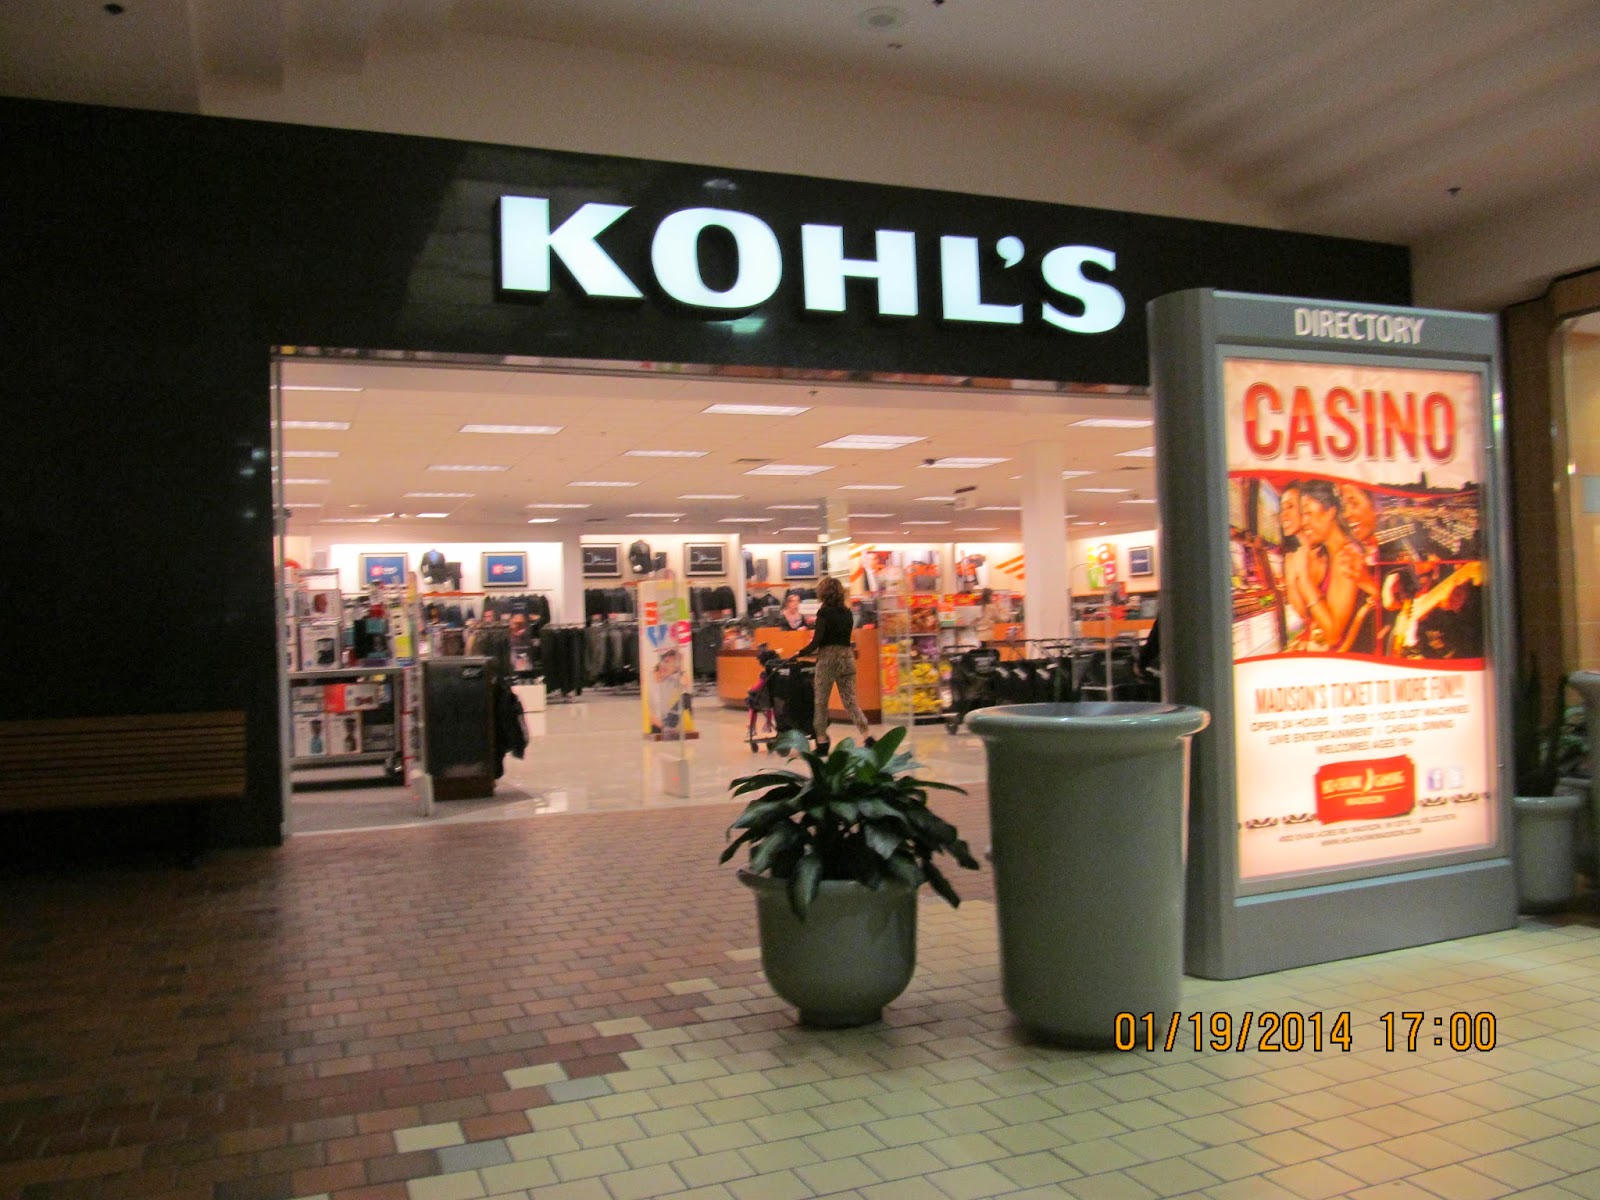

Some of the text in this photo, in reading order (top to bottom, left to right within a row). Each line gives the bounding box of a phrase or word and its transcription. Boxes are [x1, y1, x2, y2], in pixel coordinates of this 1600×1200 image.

[499, 194, 1127, 336] KOHL'S
[1293, 307, 1426, 345] DIRECTORY
[1243, 381, 1456, 464] CASINO
[1255, 685, 1328, 714] MADISON'S
[1330, 681, 1373, 708] TICKET
[1250, 721, 1279, 732] OPEN
[1296, 716, 1329, 729] HOURS
